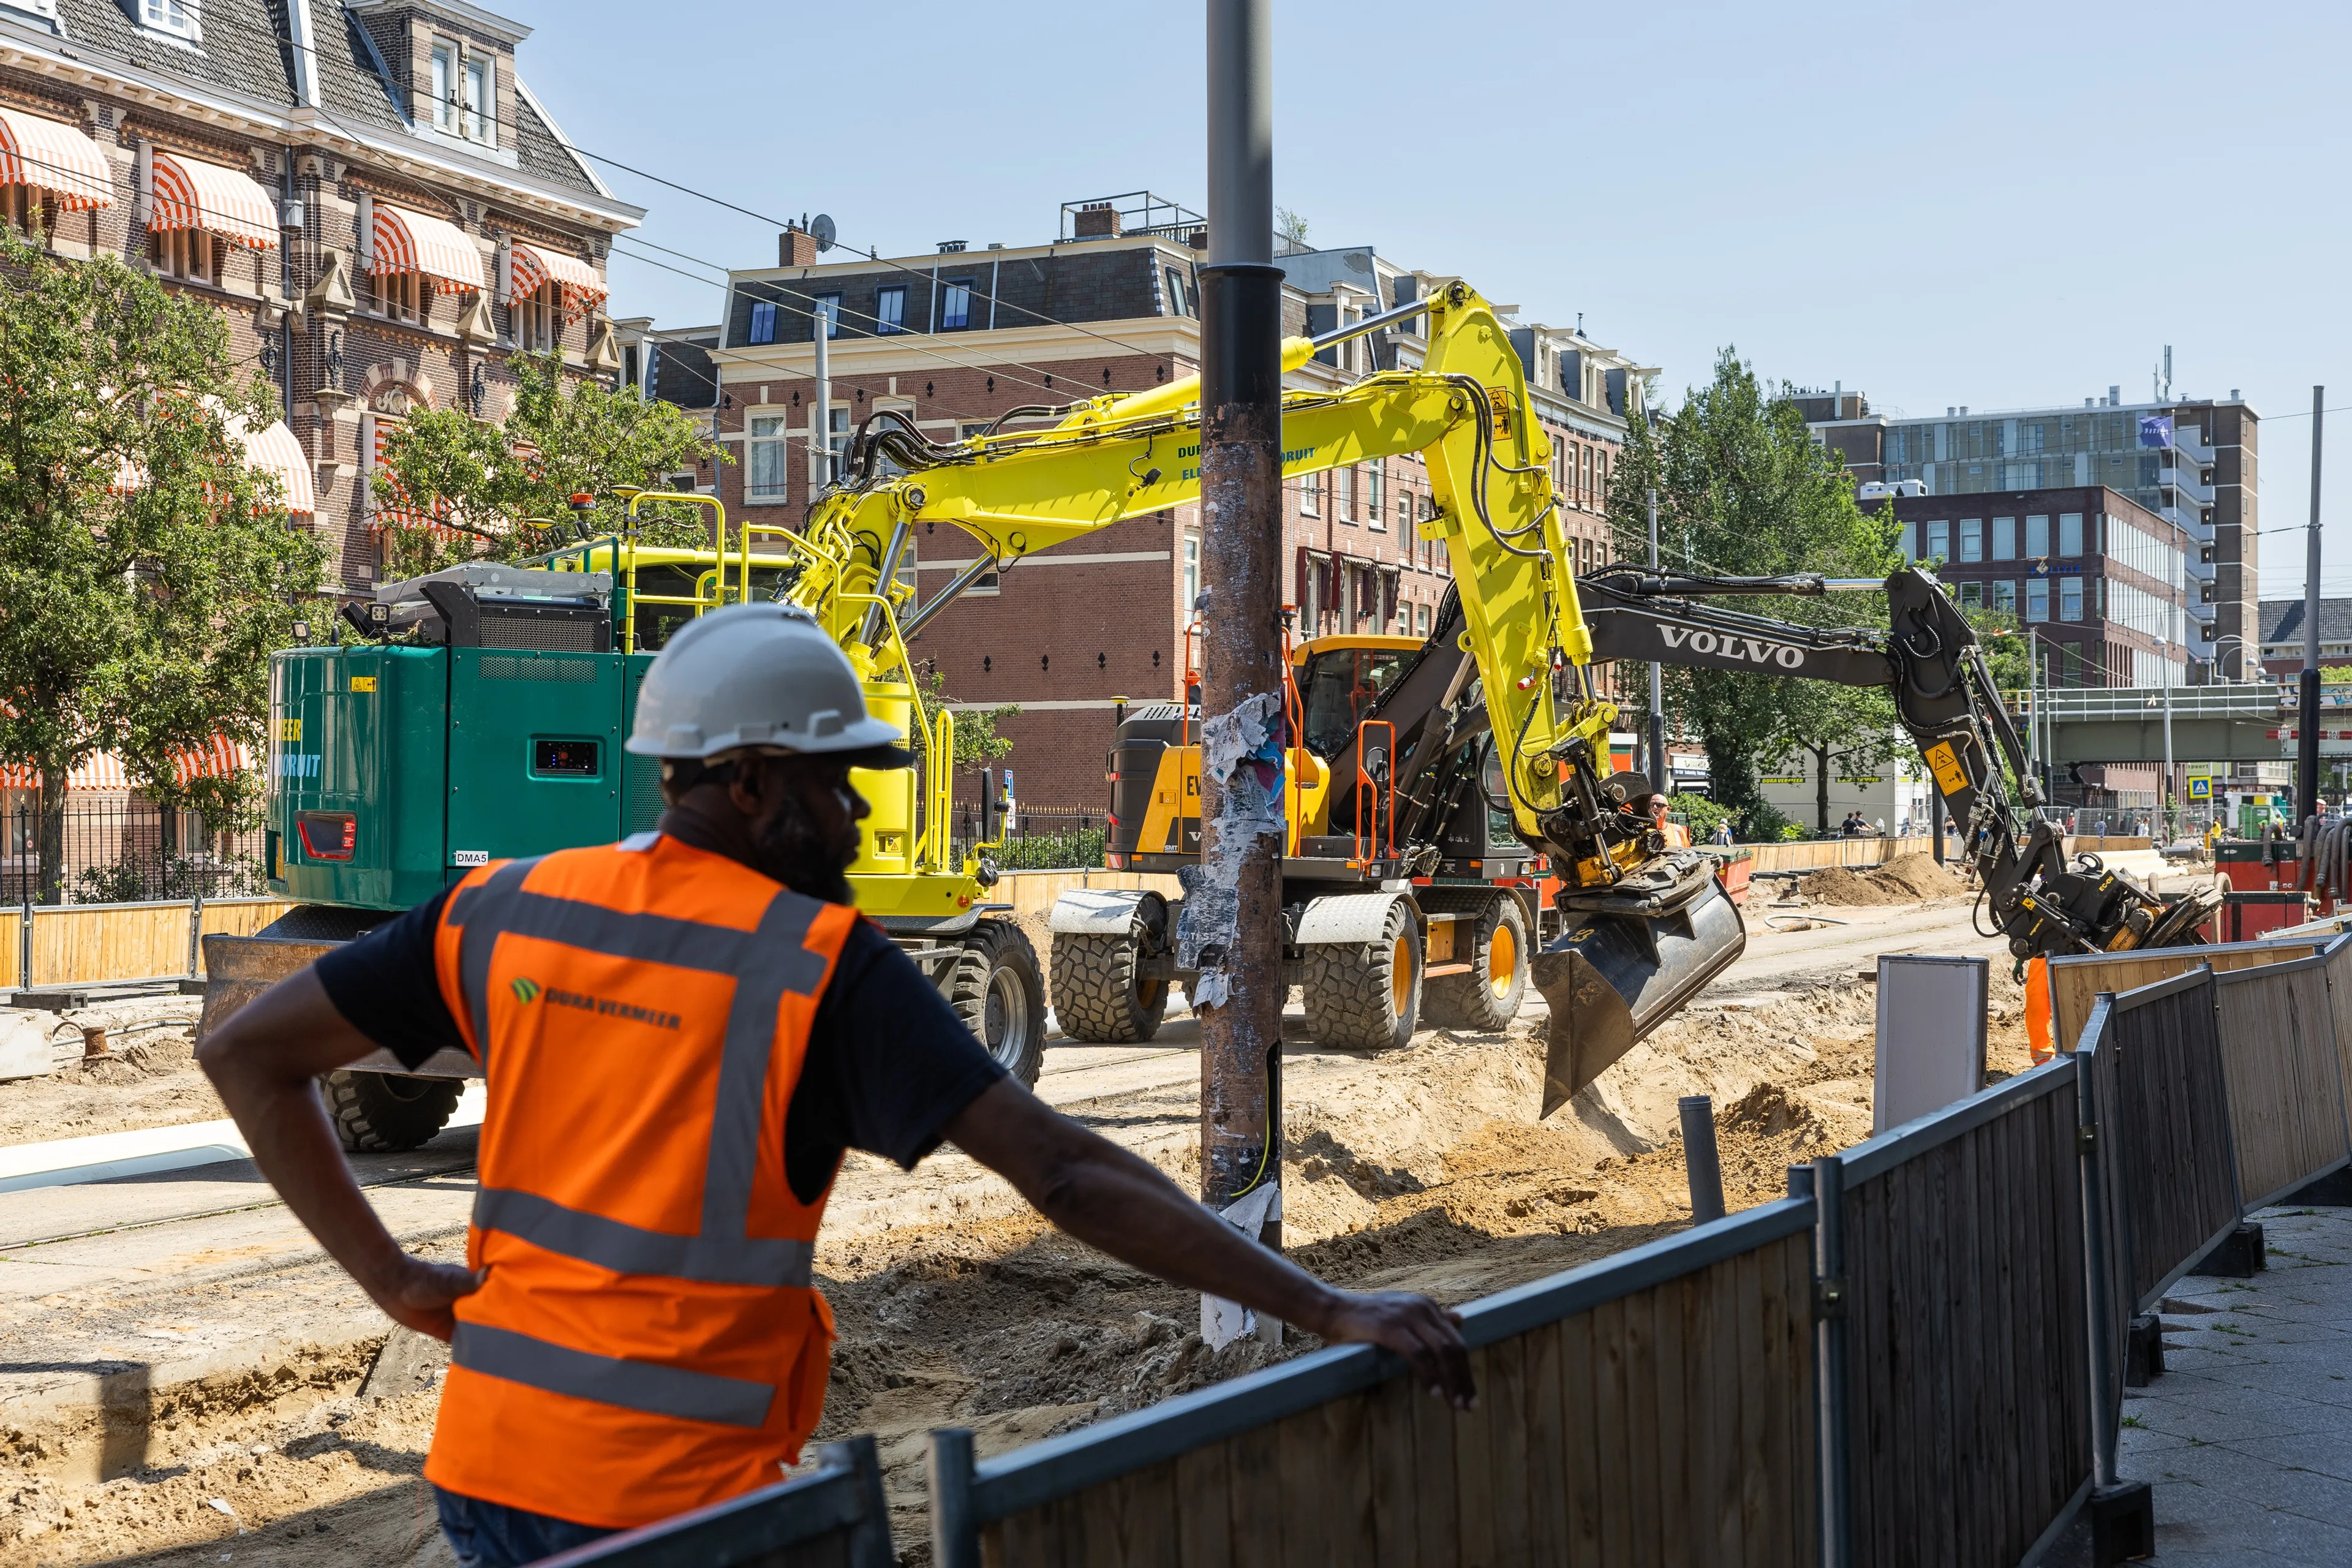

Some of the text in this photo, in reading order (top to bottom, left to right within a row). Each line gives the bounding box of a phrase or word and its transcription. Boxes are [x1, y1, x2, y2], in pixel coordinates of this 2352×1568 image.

[1656, 624, 1804, 668] VOLVO
[457, 853, 487, 862] DMA5
[545, 987, 682, 1031] DURA VERMEER
